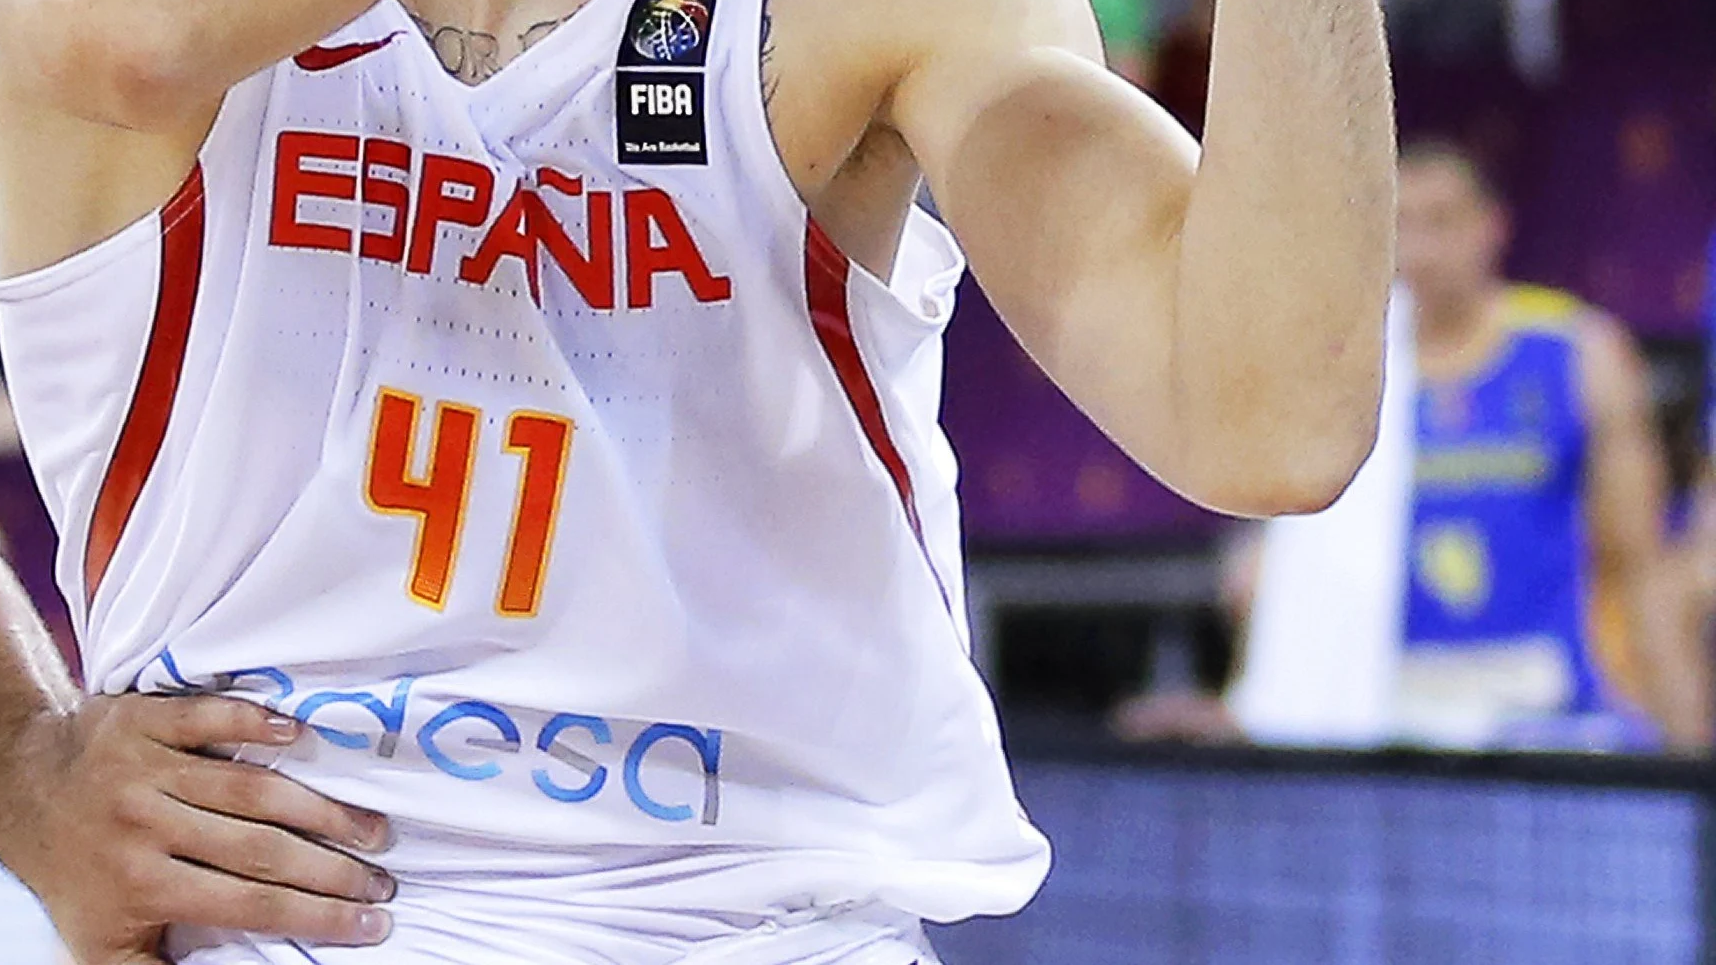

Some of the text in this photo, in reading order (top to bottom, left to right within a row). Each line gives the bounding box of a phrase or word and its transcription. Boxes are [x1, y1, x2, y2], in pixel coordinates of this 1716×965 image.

[630, 84, 693, 116] FIBA
[267, 129, 733, 312] ESPAÑA
[364, 384, 574, 618] 41
[137, 645, 722, 826] desa
